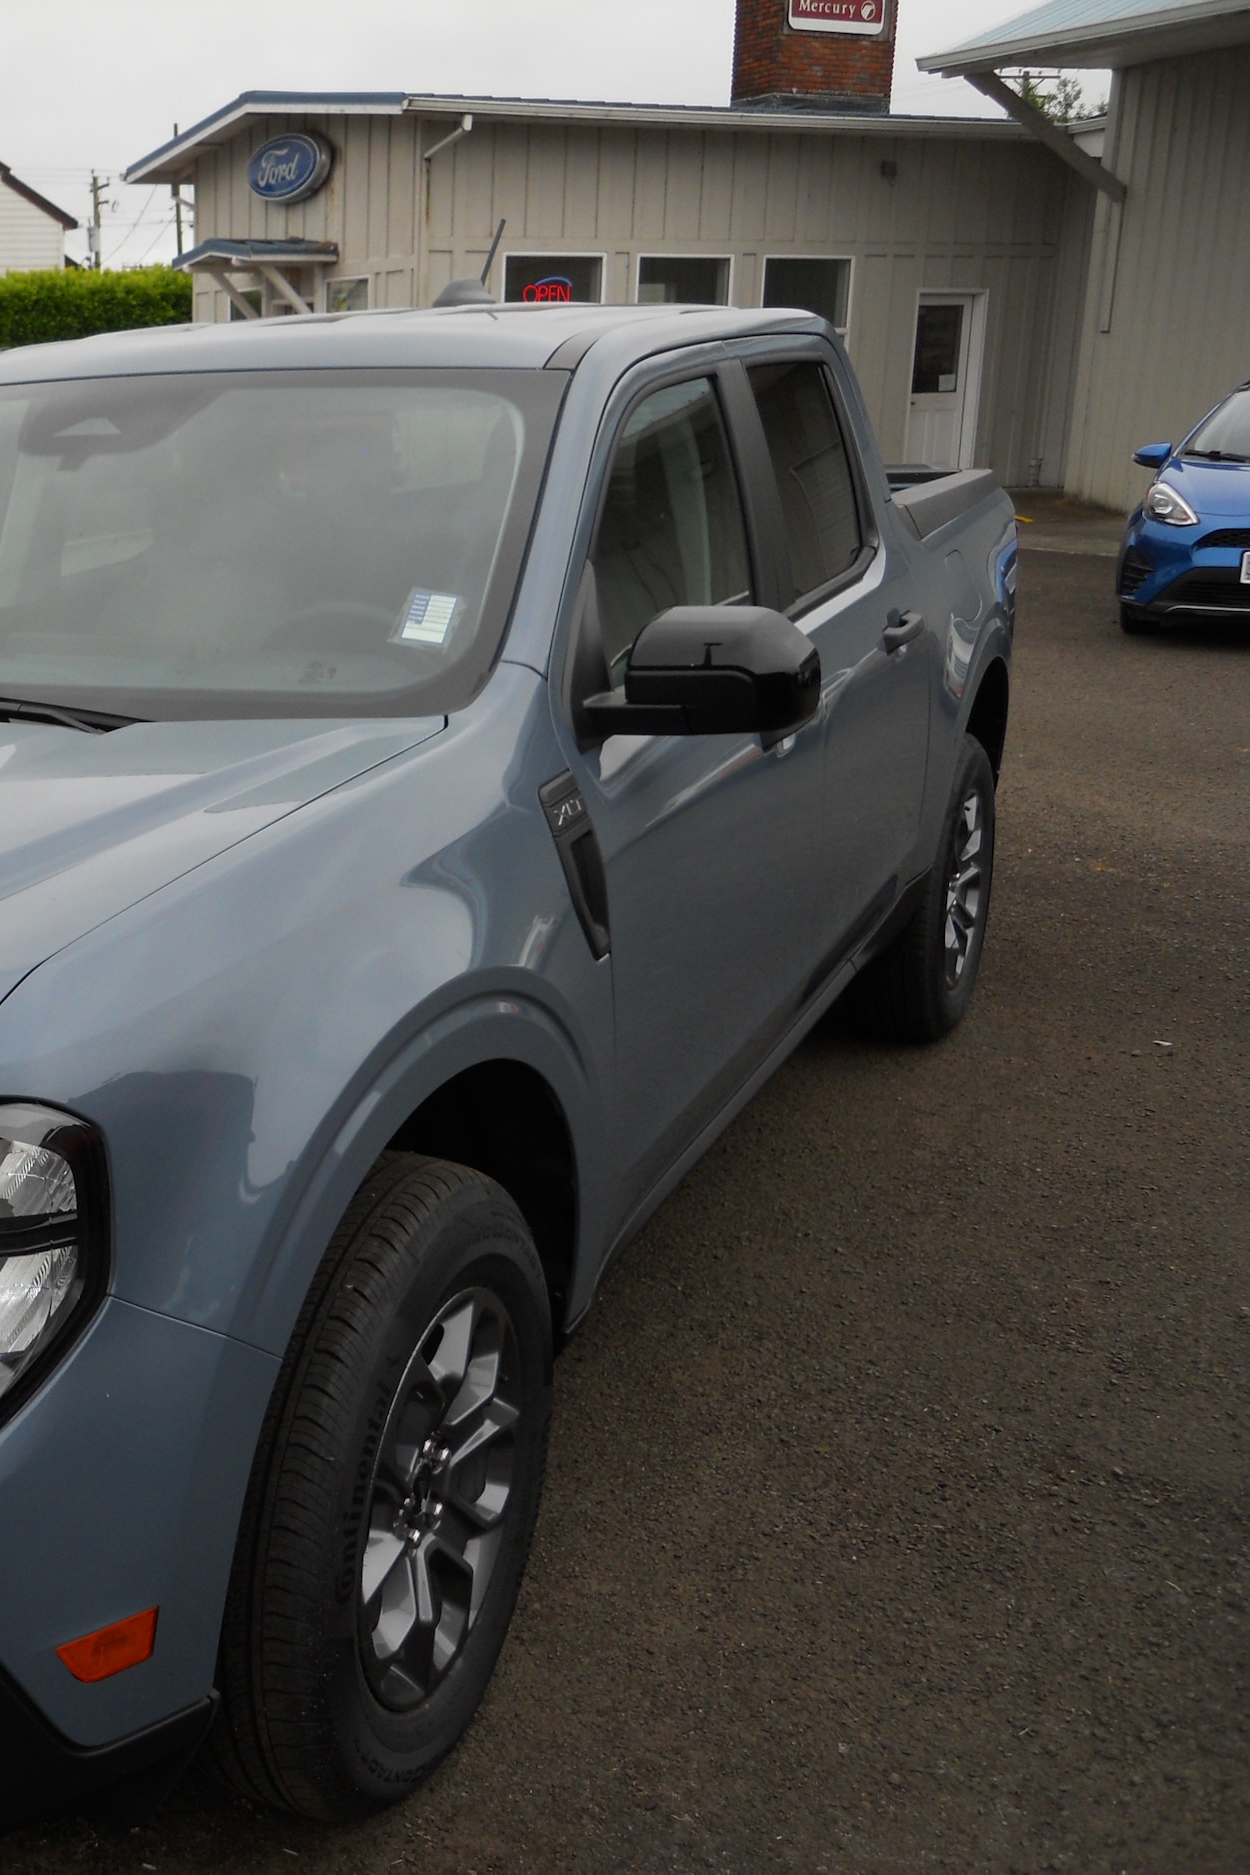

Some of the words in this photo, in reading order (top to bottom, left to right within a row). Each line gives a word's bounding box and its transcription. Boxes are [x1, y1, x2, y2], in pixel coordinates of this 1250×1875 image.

[799, 0, 855, 18] Mercury
[258, 148, 300, 188] Ford
[523, 285, 571, 303] OPEN
[554, 796, 582, 826] XLT
